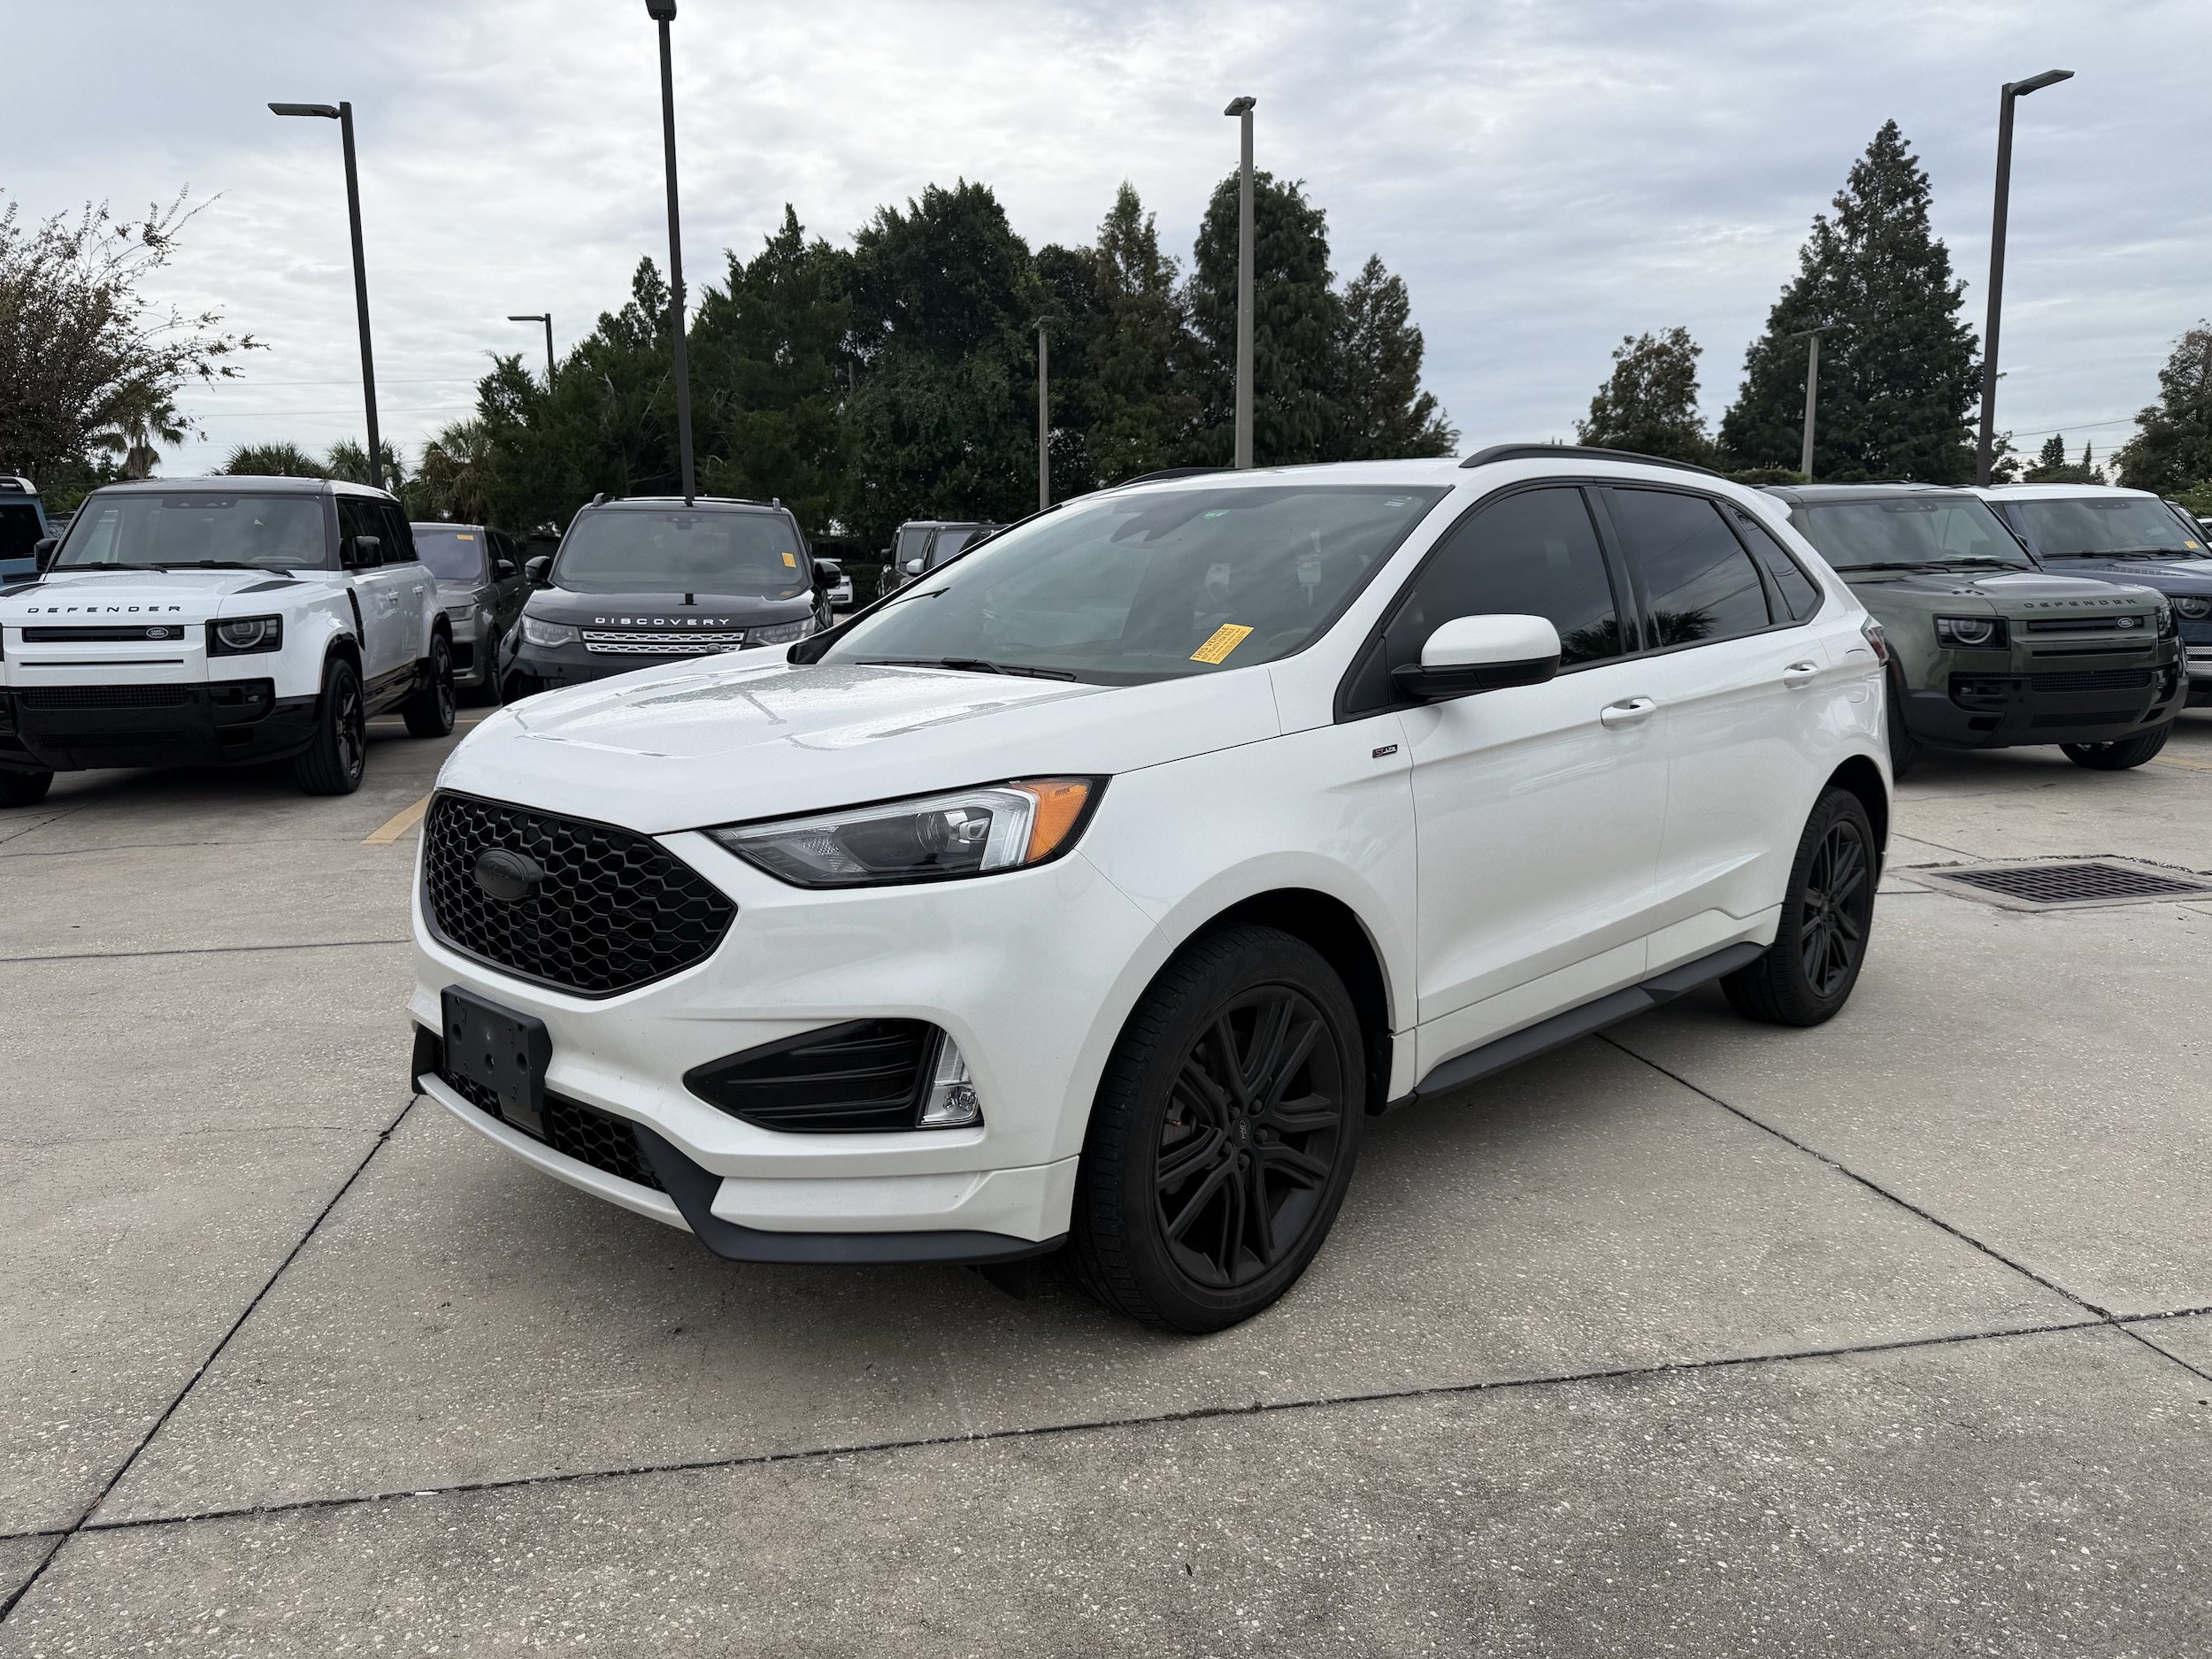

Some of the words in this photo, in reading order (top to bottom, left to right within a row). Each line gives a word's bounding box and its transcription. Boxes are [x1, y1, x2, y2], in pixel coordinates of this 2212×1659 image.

[2024, 598, 2138, 609] DEFENDER
[595, 617, 730, 626] DISCOVERY
[1193, 647, 1208, 658] THIS
[1204, 626, 1229, 647] VEHICLE
